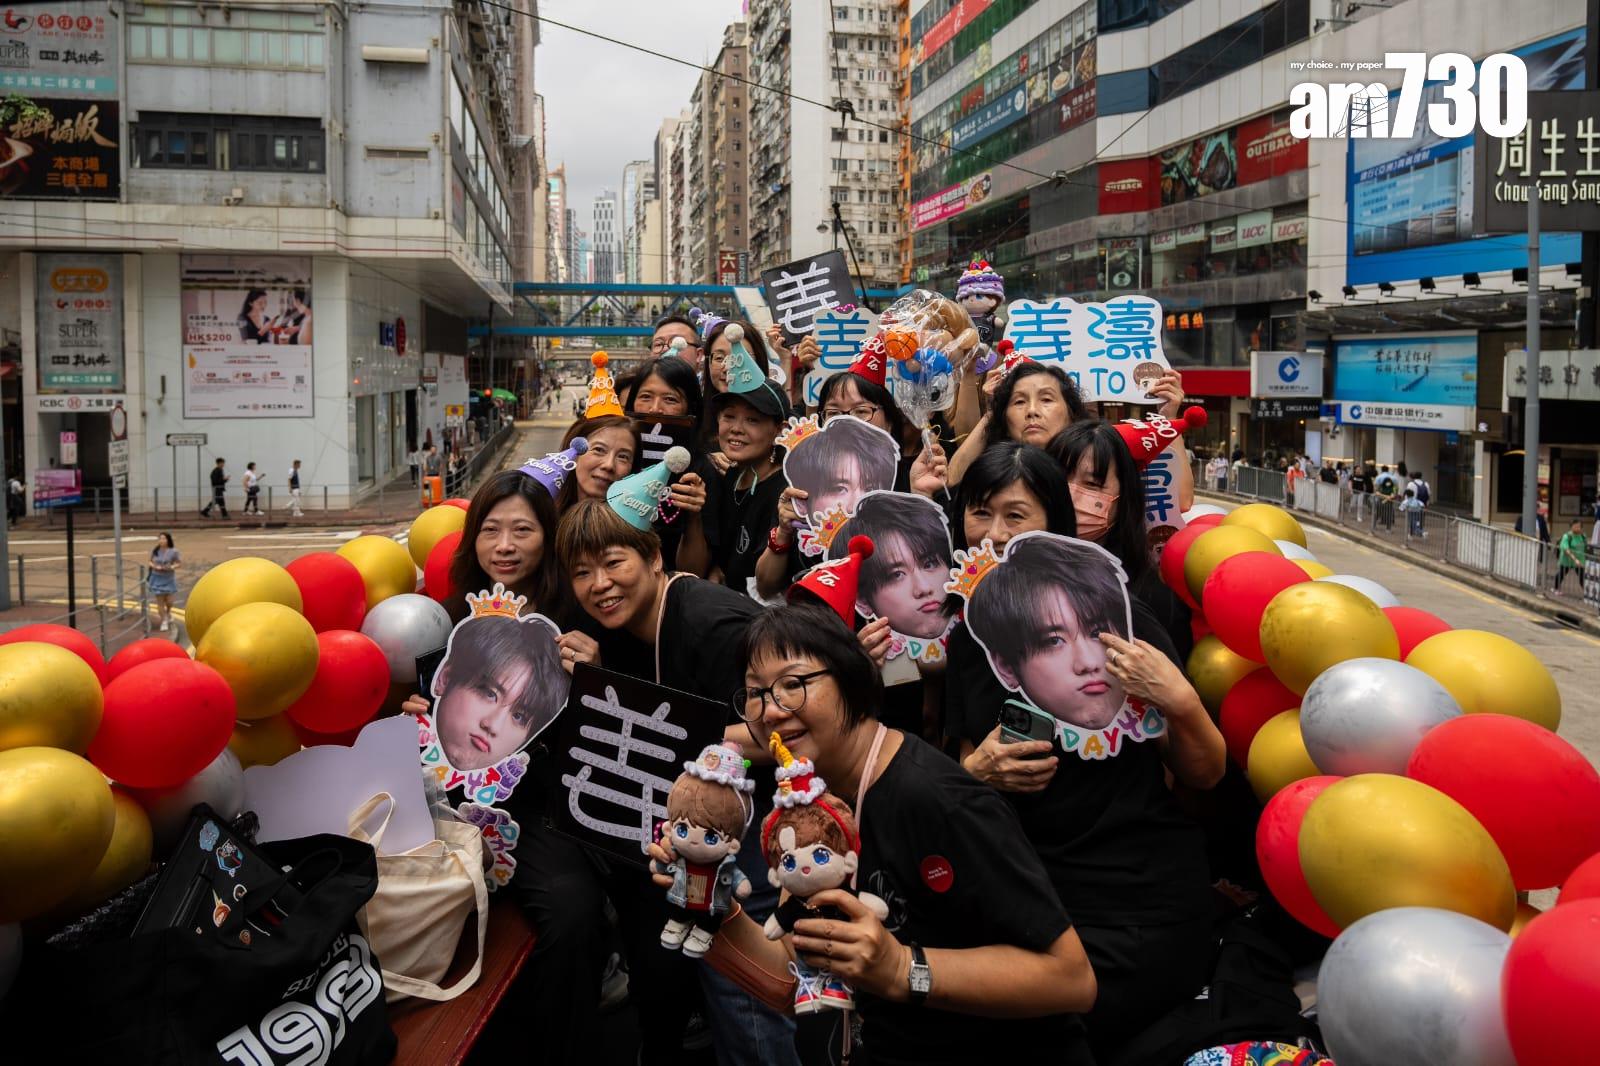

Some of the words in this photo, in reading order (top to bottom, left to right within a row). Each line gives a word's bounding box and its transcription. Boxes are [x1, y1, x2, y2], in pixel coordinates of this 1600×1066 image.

[1496, 117, 1600, 176] 周生生
[1536, 180, 1568, 204] Sang
[1242, 225, 1267, 239] UCC
[58, 324, 98, 338] SUPER
[1010, 300, 1157, 362] 姜濤
[39, 400, 64, 408] ICBC
[1063, 726, 1119, 757] DAY
